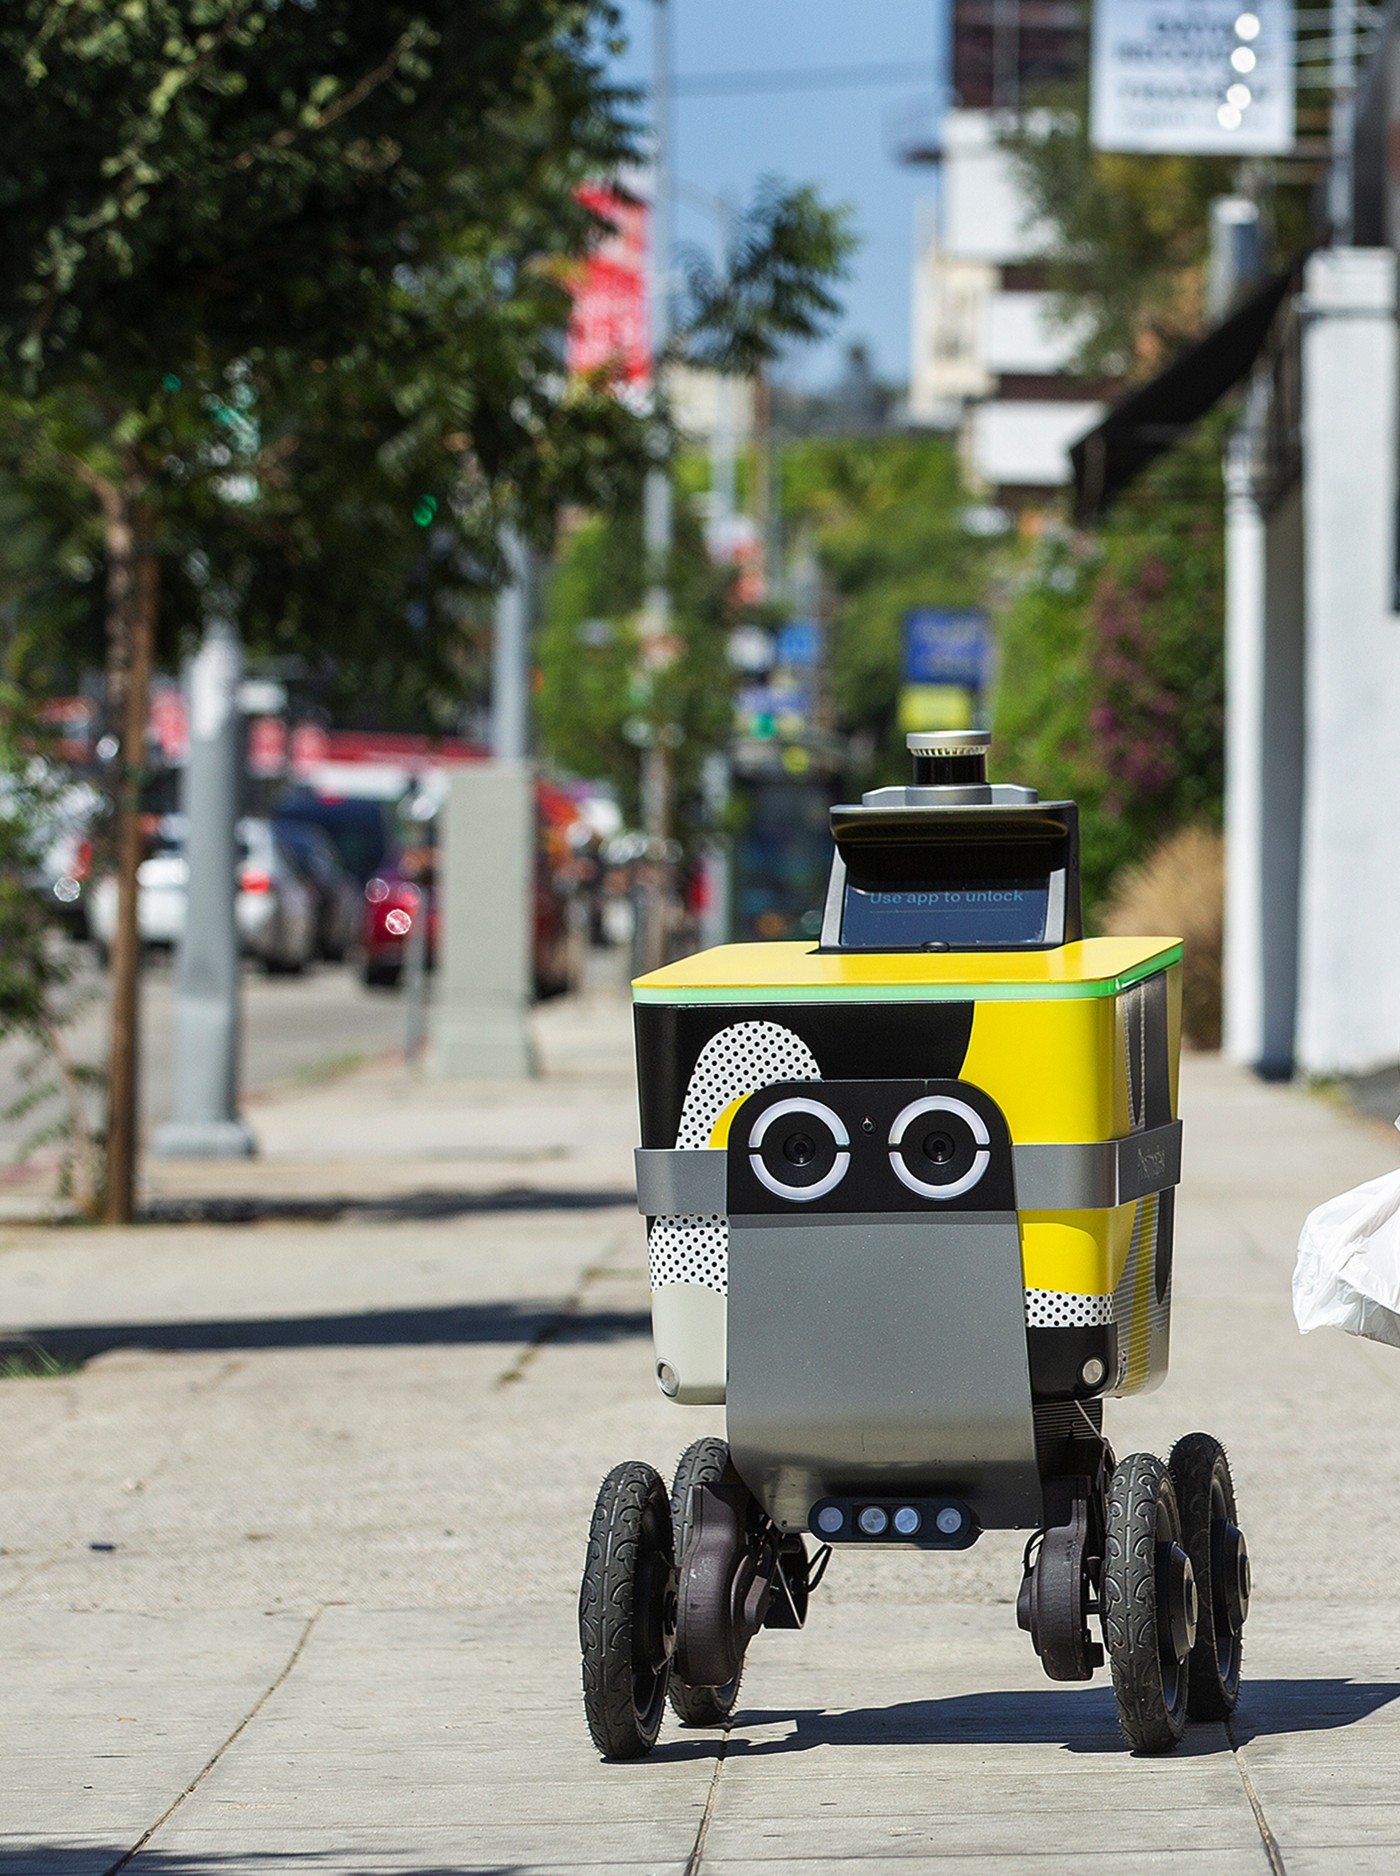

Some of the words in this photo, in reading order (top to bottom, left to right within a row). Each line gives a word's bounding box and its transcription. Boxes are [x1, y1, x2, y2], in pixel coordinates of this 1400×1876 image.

[870, 892, 902, 905] Use
[906, 893, 940, 907] app
[944, 891, 961, 904] to
[966, 890, 1024, 904] unlock
